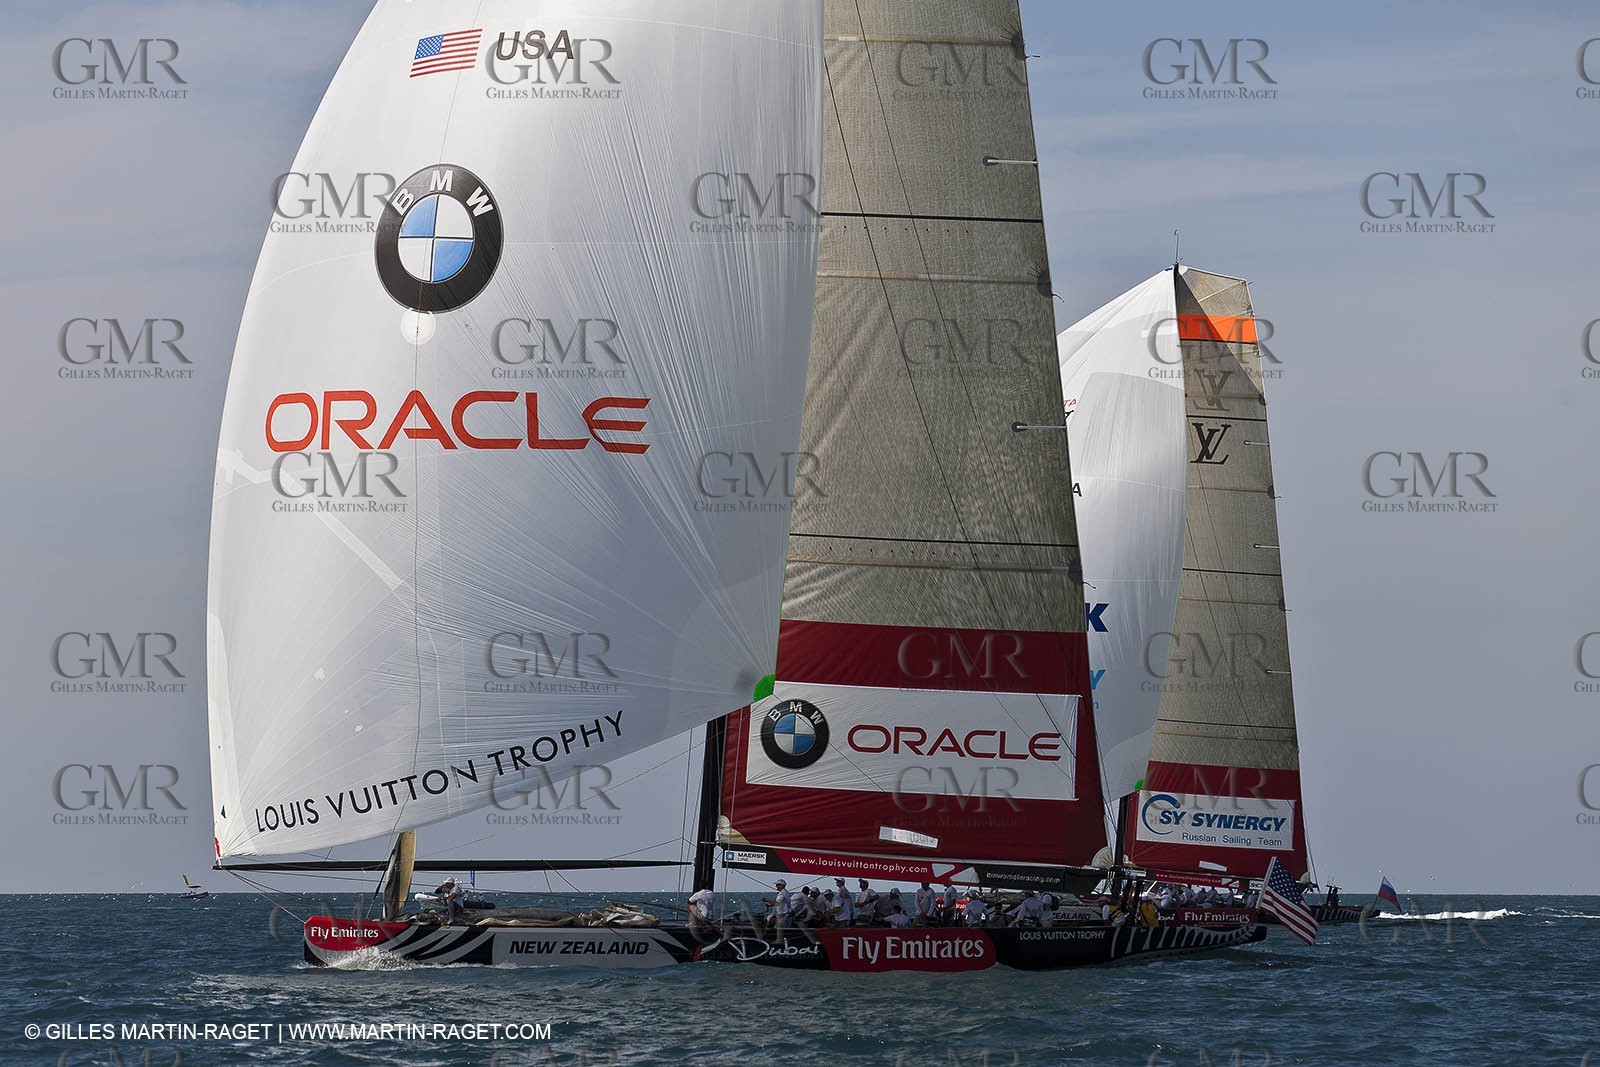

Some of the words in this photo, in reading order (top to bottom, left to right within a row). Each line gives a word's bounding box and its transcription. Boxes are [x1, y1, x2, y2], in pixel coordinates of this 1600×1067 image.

[495, 29, 575, 61] USA
[392, 169, 495, 218] BMW
[265, 390, 652, 454] ORACLE
[768, 701, 825, 726] BMW
[847, 724, 1063, 762] ORACLE
[255, 798, 320, 833] LOUIS
[326, 759, 479, 819] VUITTON
[487, 710, 624, 779] TROPHY
[1159, 810, 1188, 825] SY
[1191, 812, 1287, 832] SYNERGY
[1182, 832, 1217, 843] Russian
[1222, 834, 1251, 846] Sailing
[1258, 837, 1282, 847] Team
[738, 852, 766, 860] MAERSK
[791, 857, 928, 873] www.louisvuittontrophy.com
[310, 926, 329, 940] Fly
[331, 926, 380, 938] Emirates
[1019, 930, 1041, 941] LOUIS
[1042, 930, 1077, 941] VUITTON
[1078, 930, 1106, 941] TROPHY
[509, 940, 561, 955] NEW
[560, 940, 650, 955] ZEALAND
[727, 936, 821, 961] Dubai
[842, 936, 881, 965] Fly
[886, 934, 984, 960] Emirates
